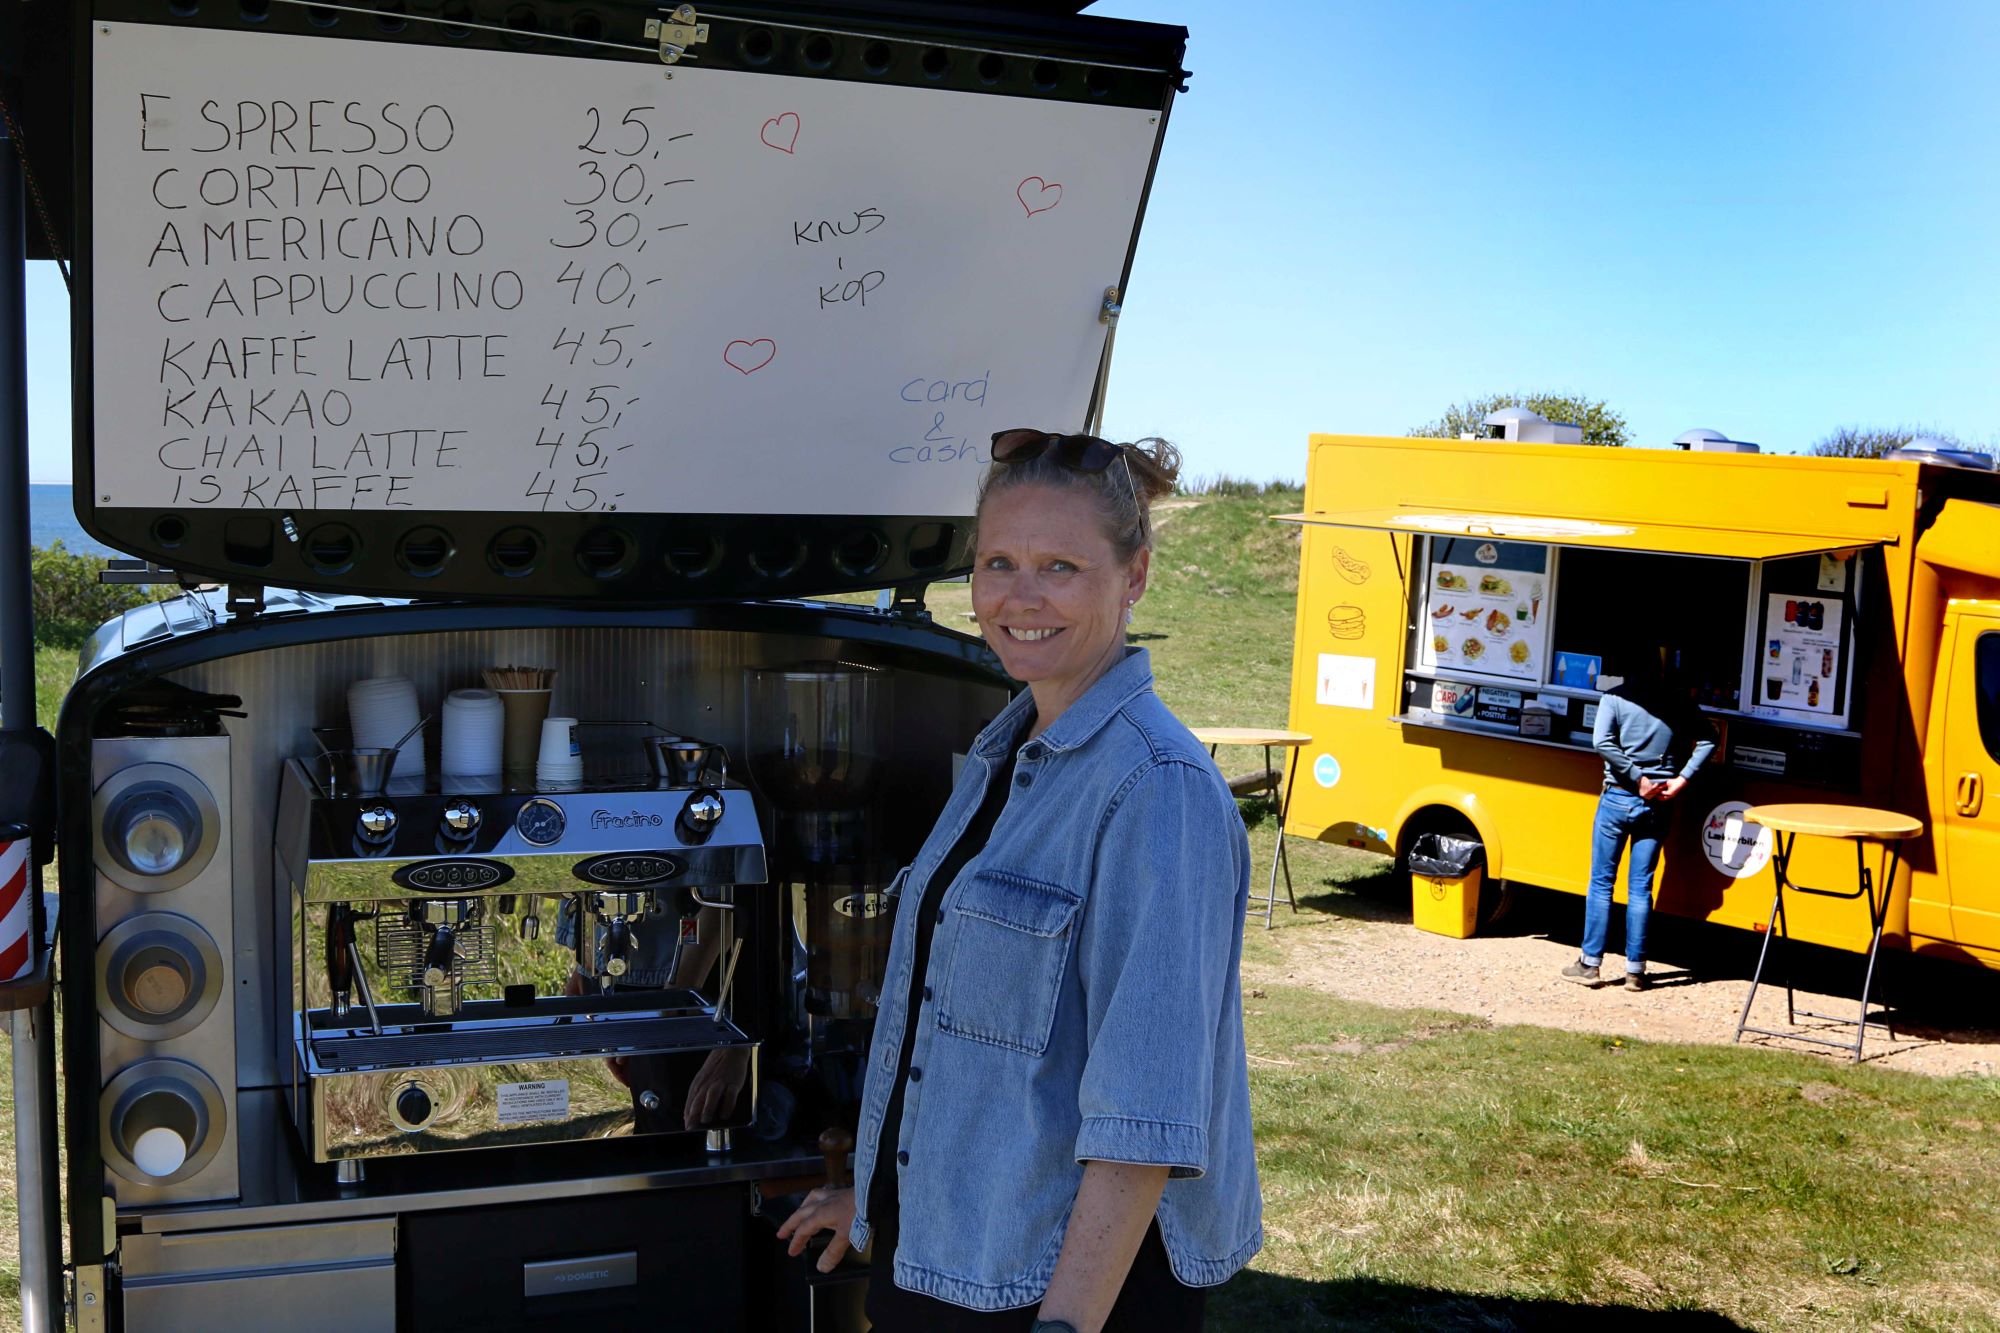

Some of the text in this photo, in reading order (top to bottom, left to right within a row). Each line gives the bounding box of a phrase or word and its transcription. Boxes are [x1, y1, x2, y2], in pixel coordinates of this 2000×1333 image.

[140, 93, 454, 155] ESPRESSO
[152, 164, 431, 209] CORTADO
[148, 213, 484, 267] AMERICANO
[157, 270, 524, 322] CAPPUCCINO
[348, 334, 508, 381] LATTE
[162, 387, 352, 429] KAKAO
[923, 411, 955, 441] &
[158, 434, 283, 471] CHAI
[312, 430, 468, 471] LATTE
[1435, 690, 1457, 703] CARD
[1482, 688, 1509, 698] NEGATIVE
[1481, 710, 1507, 720] POSITIVE
[518, 1082, 545, 1091] WARNING
[567, 1270, 608, 1280] DOMETIC
